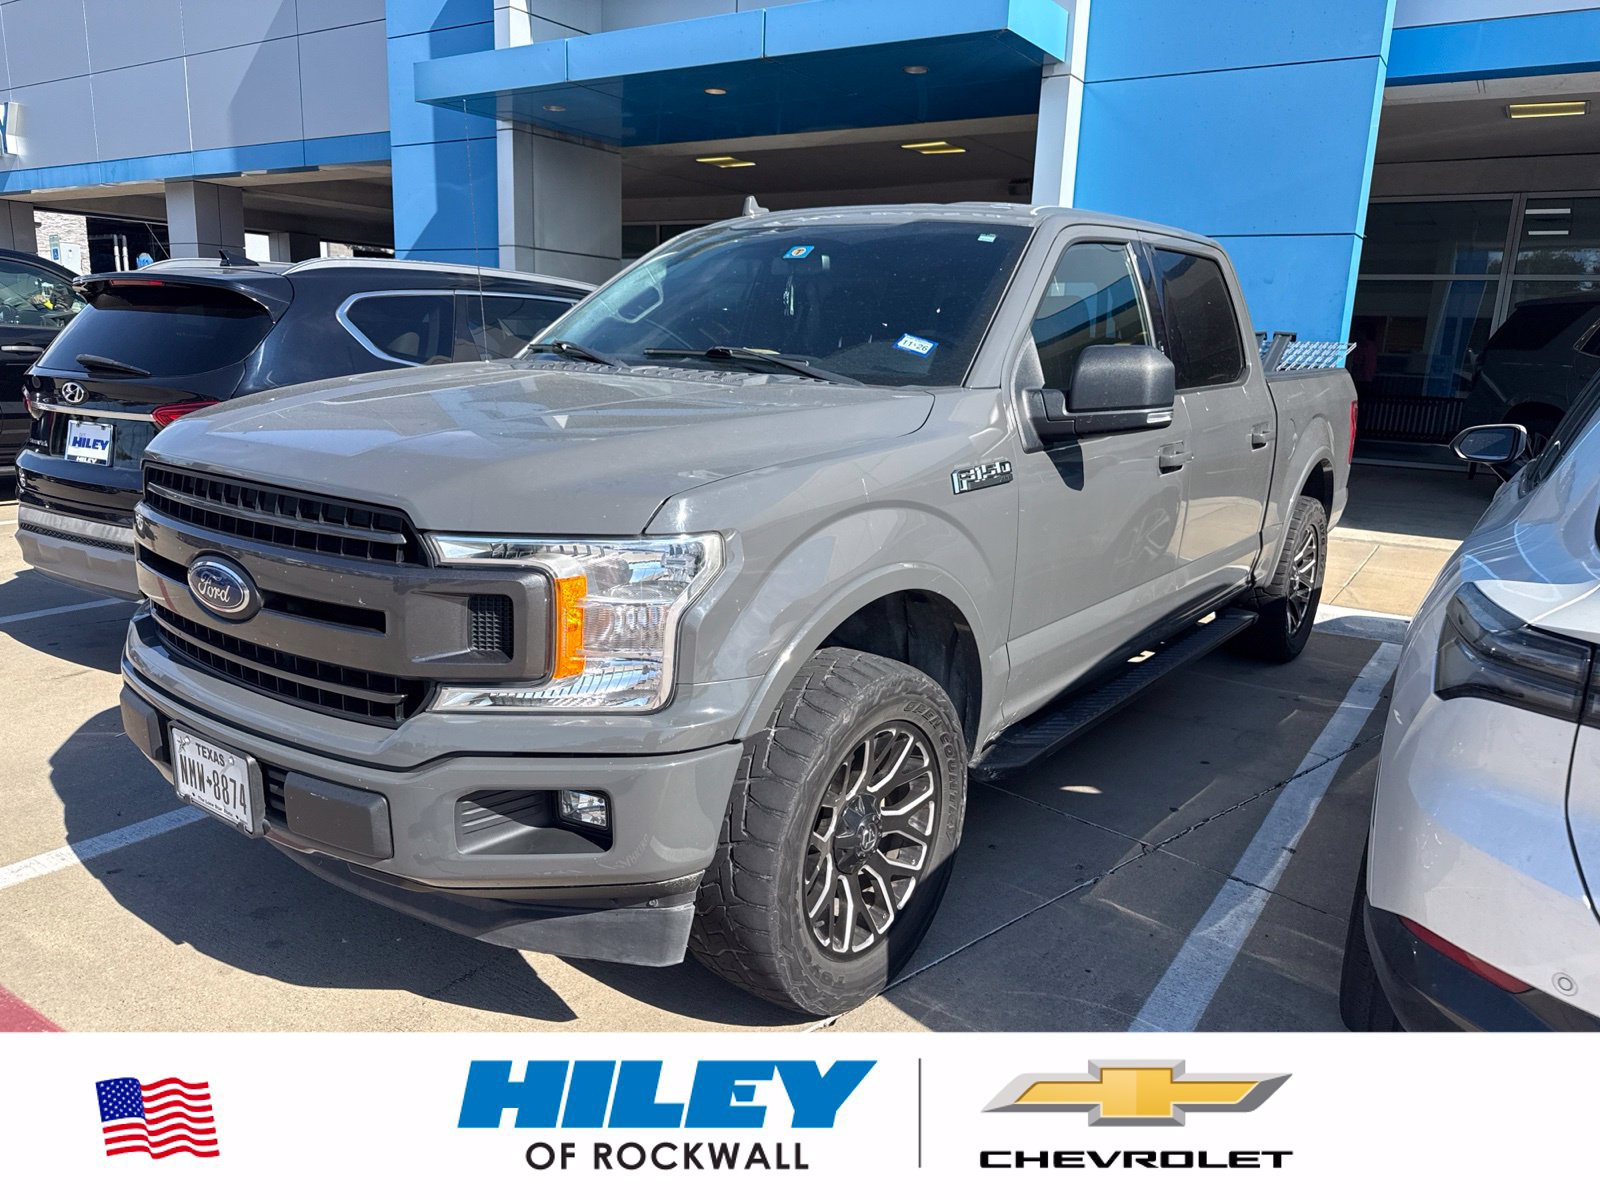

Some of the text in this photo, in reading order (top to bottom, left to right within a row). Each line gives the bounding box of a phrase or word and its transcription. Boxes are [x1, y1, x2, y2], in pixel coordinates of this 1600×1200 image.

[72, 436, 109, 450] HILEY
[76, 456, 97, 464] HILEY
[198, 571, 231, 602] Ford
[903, 700, 942, 729] OPEN
[196, 743, 225, 767] TEXAS
[940, 731, 959, 841] COUNTRY
